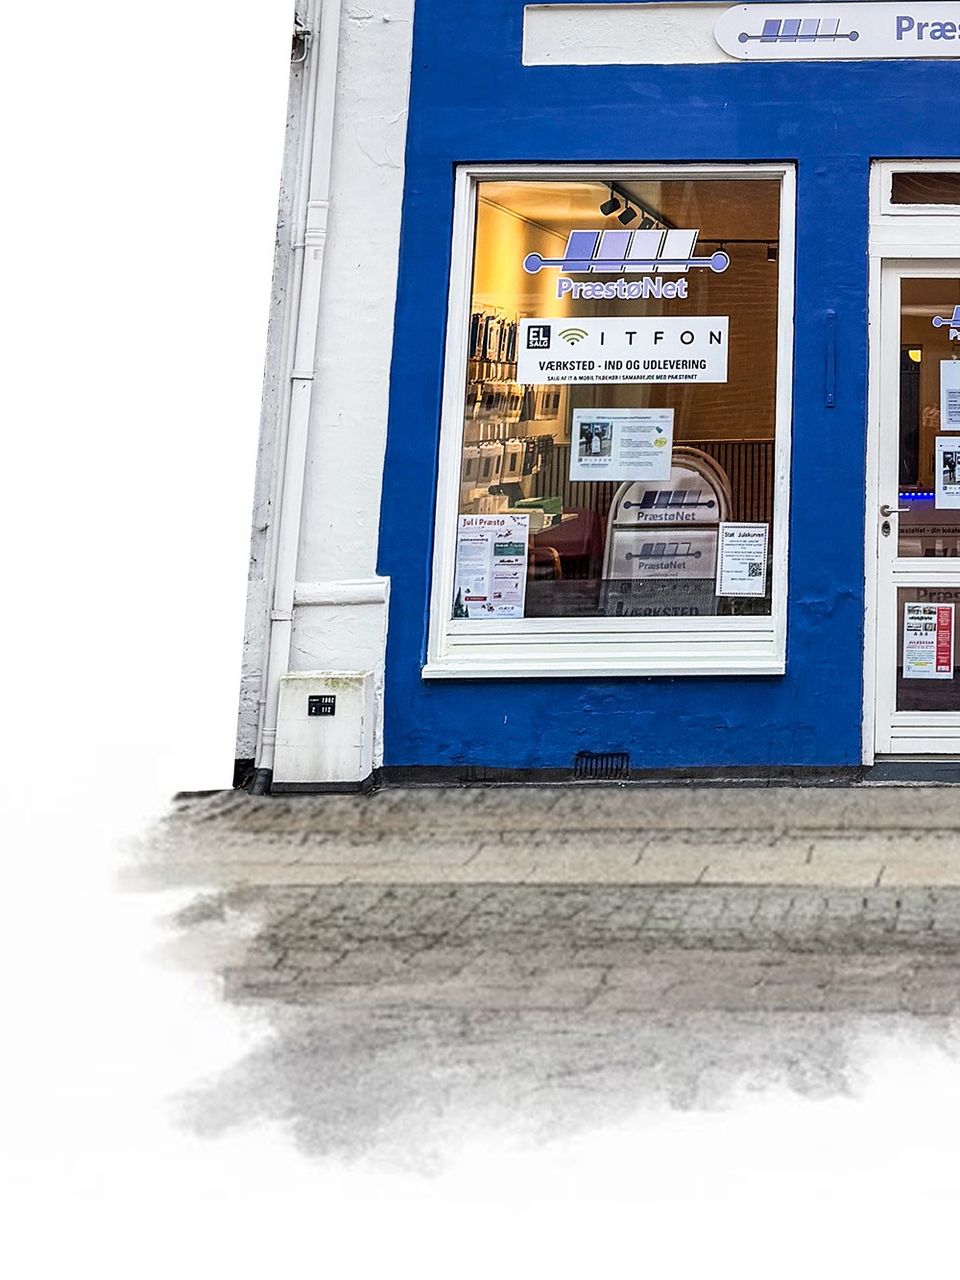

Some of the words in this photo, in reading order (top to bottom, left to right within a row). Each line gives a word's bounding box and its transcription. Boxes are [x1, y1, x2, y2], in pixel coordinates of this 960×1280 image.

[557, 276, 688, 300] PræstøNet
[530, 327, 549, 341] EL
[529, 340, 549, 348] SALG
[539, 361, 595, 372] VÆRKSTED
[604, 360, 623, 371] IND
[626, 360, 641, 370] OG
[643, 359, 707, 370] UDLEVERING
[637, 512, 697, 521] PræstøNet
[463, 518, 474, 528] Jul
[639, 561, 686, 570] PræstøNet
